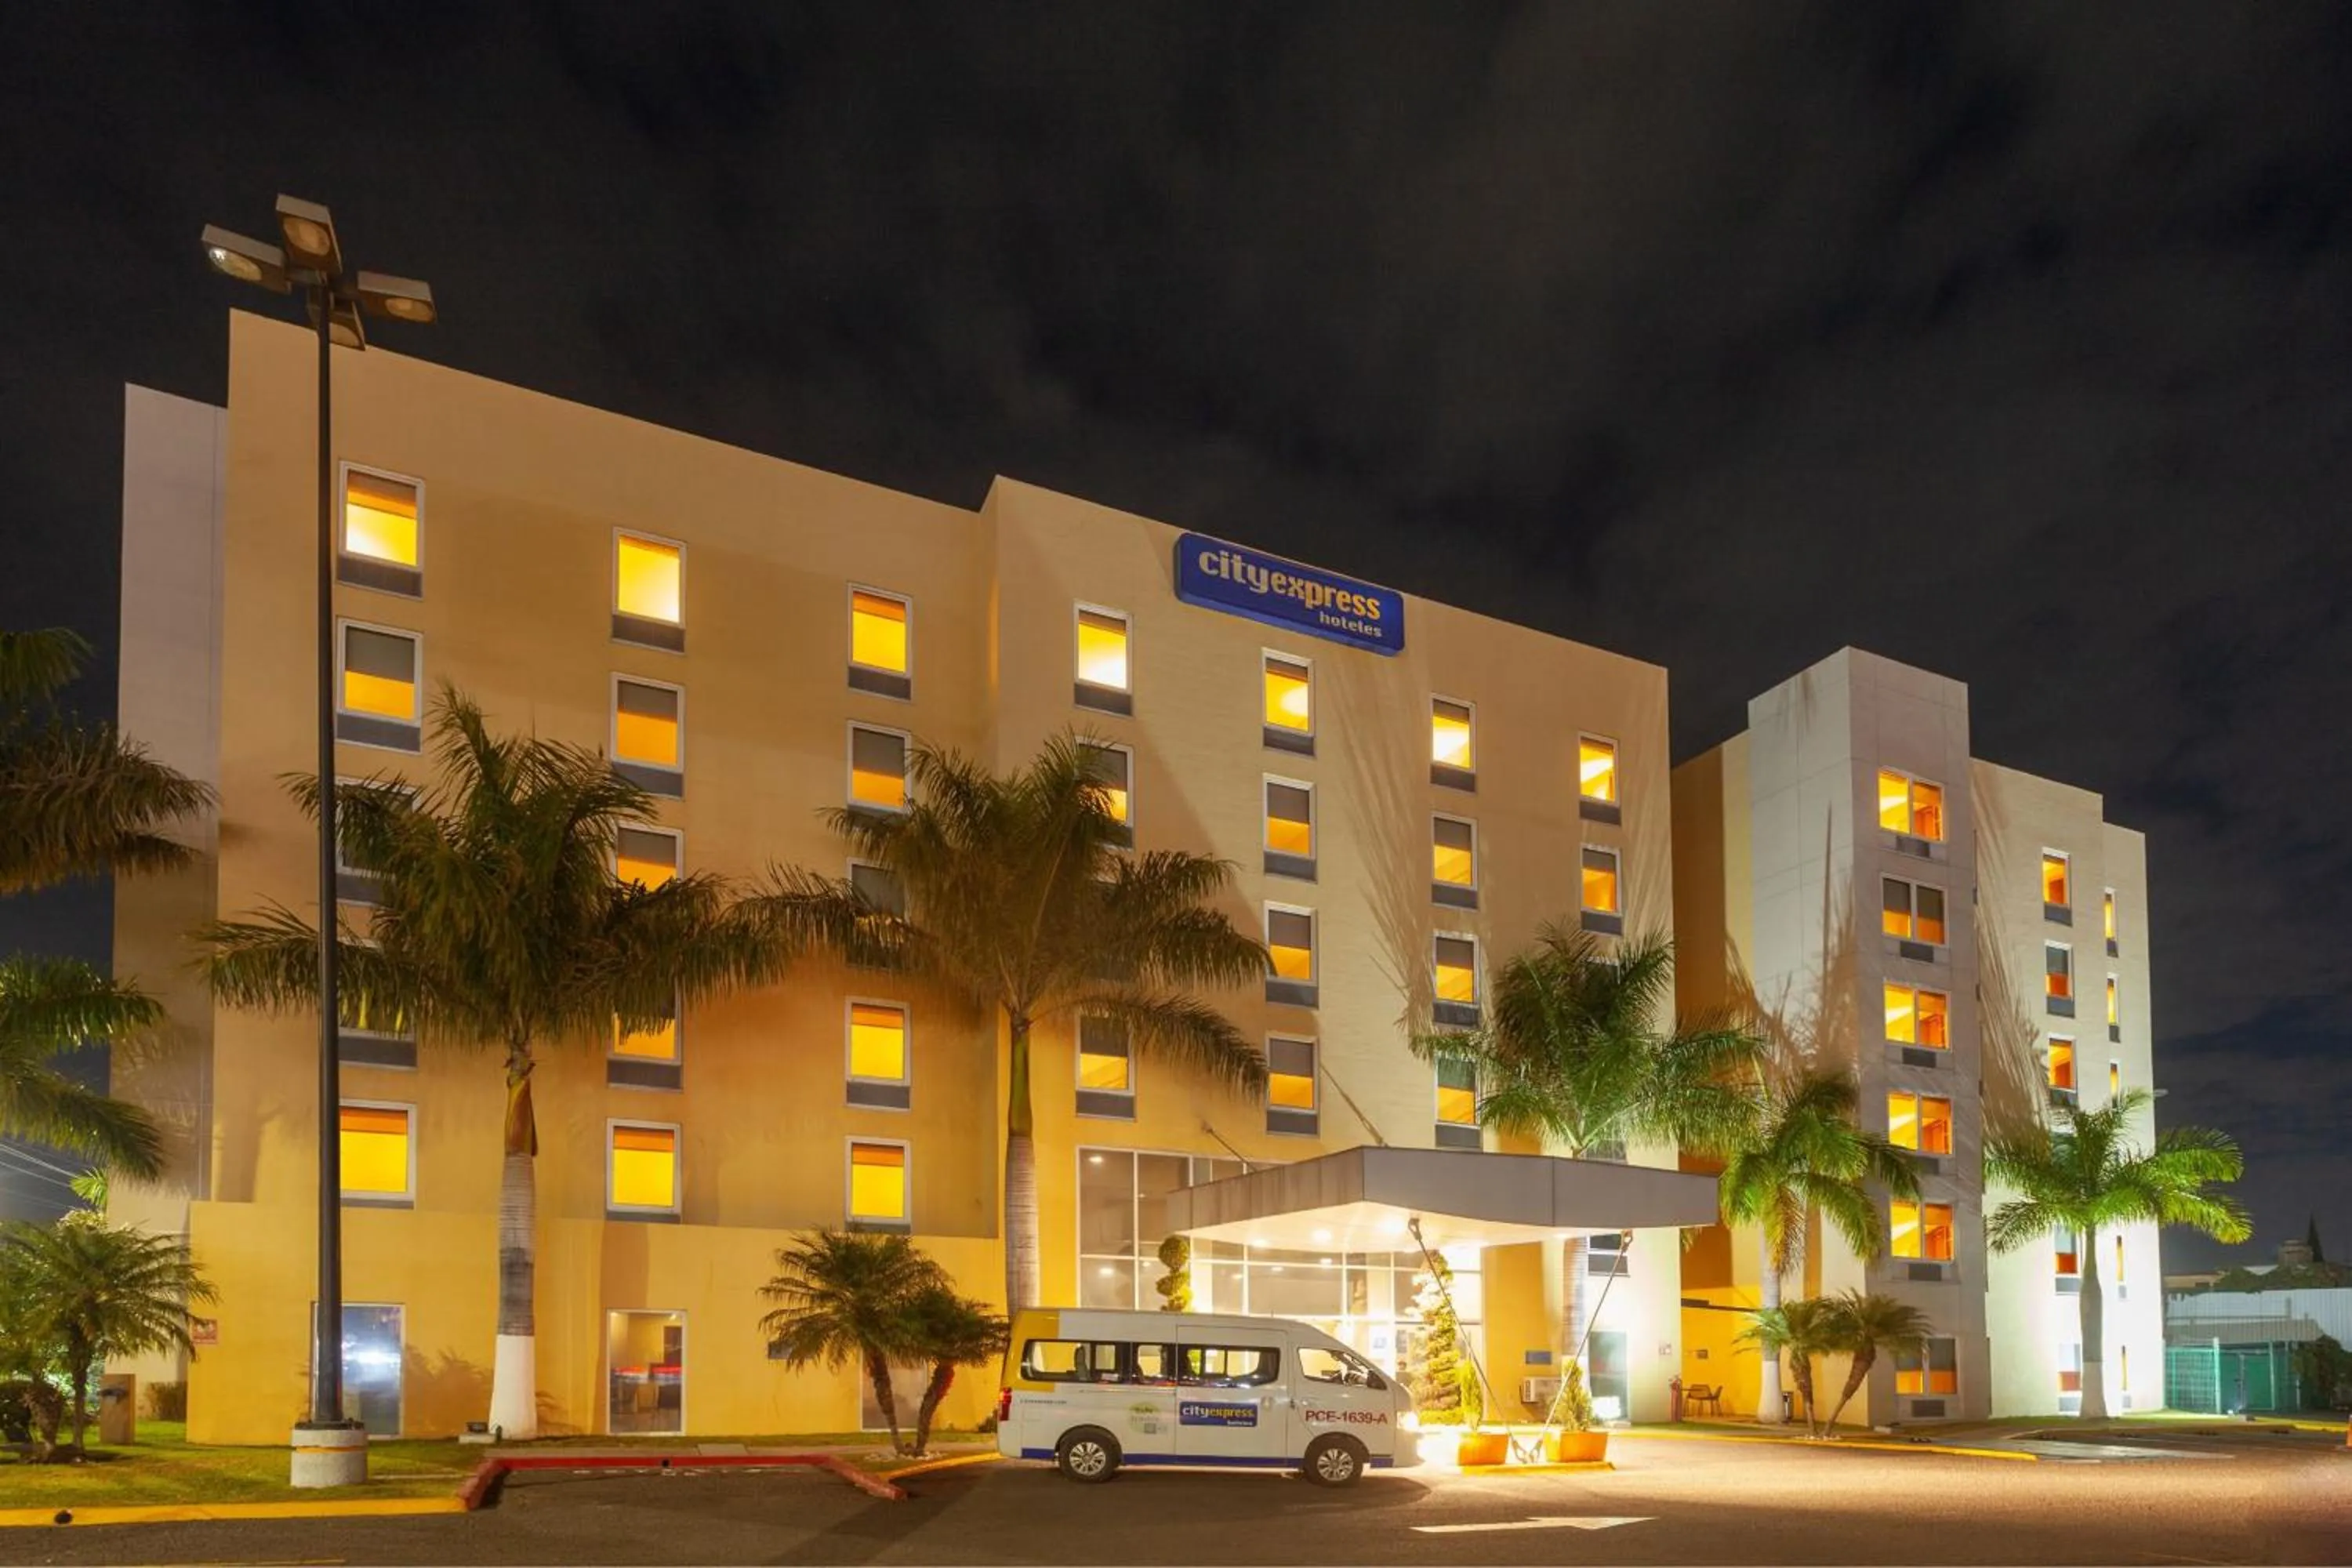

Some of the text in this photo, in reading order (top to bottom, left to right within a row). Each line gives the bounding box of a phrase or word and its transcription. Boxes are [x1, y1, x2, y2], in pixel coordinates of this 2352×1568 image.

[1199, 550, 1381, 620] cityexpress
[1319, 611, 1382, 637] hoteles
[1305, 1410, 1388, 1425] PCE-1639-A
